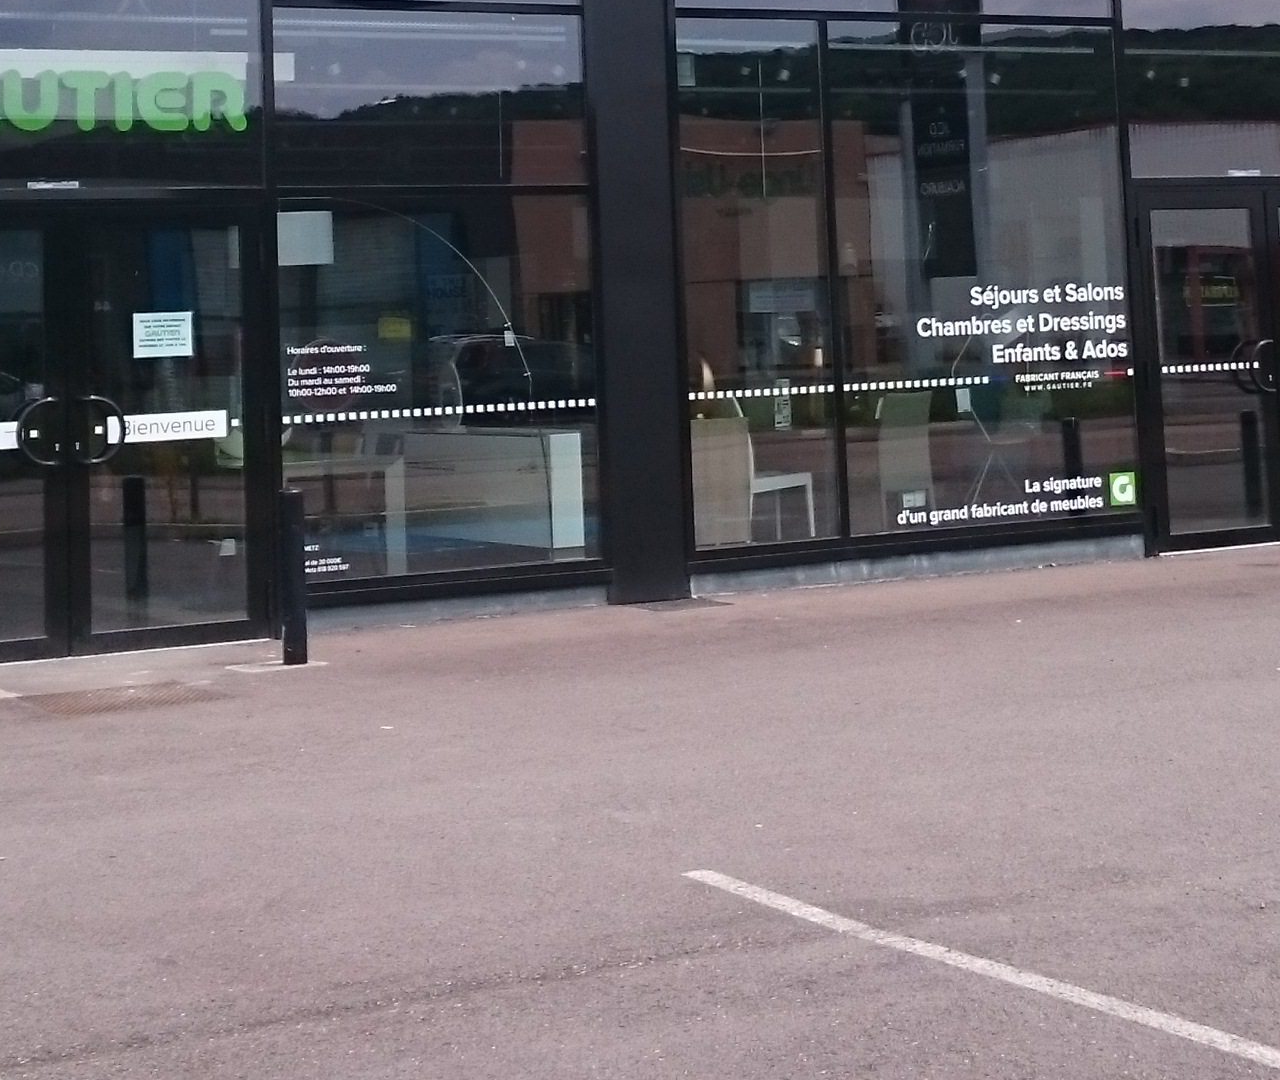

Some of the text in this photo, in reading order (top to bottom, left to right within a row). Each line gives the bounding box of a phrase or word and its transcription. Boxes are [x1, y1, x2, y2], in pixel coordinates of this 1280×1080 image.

[970, 282, 1125, 310] Séjours et Salons
[916, 311, 1127, 338] Chambres et Dressings
[287, 346, 319, 355] Horaires
[992, 339, 1128, 364] Enfants & Ados
[287, 368, 298, 376] Le
[299, 367, 317, 376] lundi
[1015, 370, 1100, 384] FABRICANT FRANÇAIS
[288, 378, 299, 387] Du
[300, 376, 322, 386] mardi
[334, 375, 361, 385] samedi
[338, 387, 347, 395] et
[122, 417, 217, 437] Bienvenue
[1024, 479, 1042, 494] La
[1043, 476, 1103, 494] signature
[897, 494, 1105, 526] d'un grand fabricant de meubles
